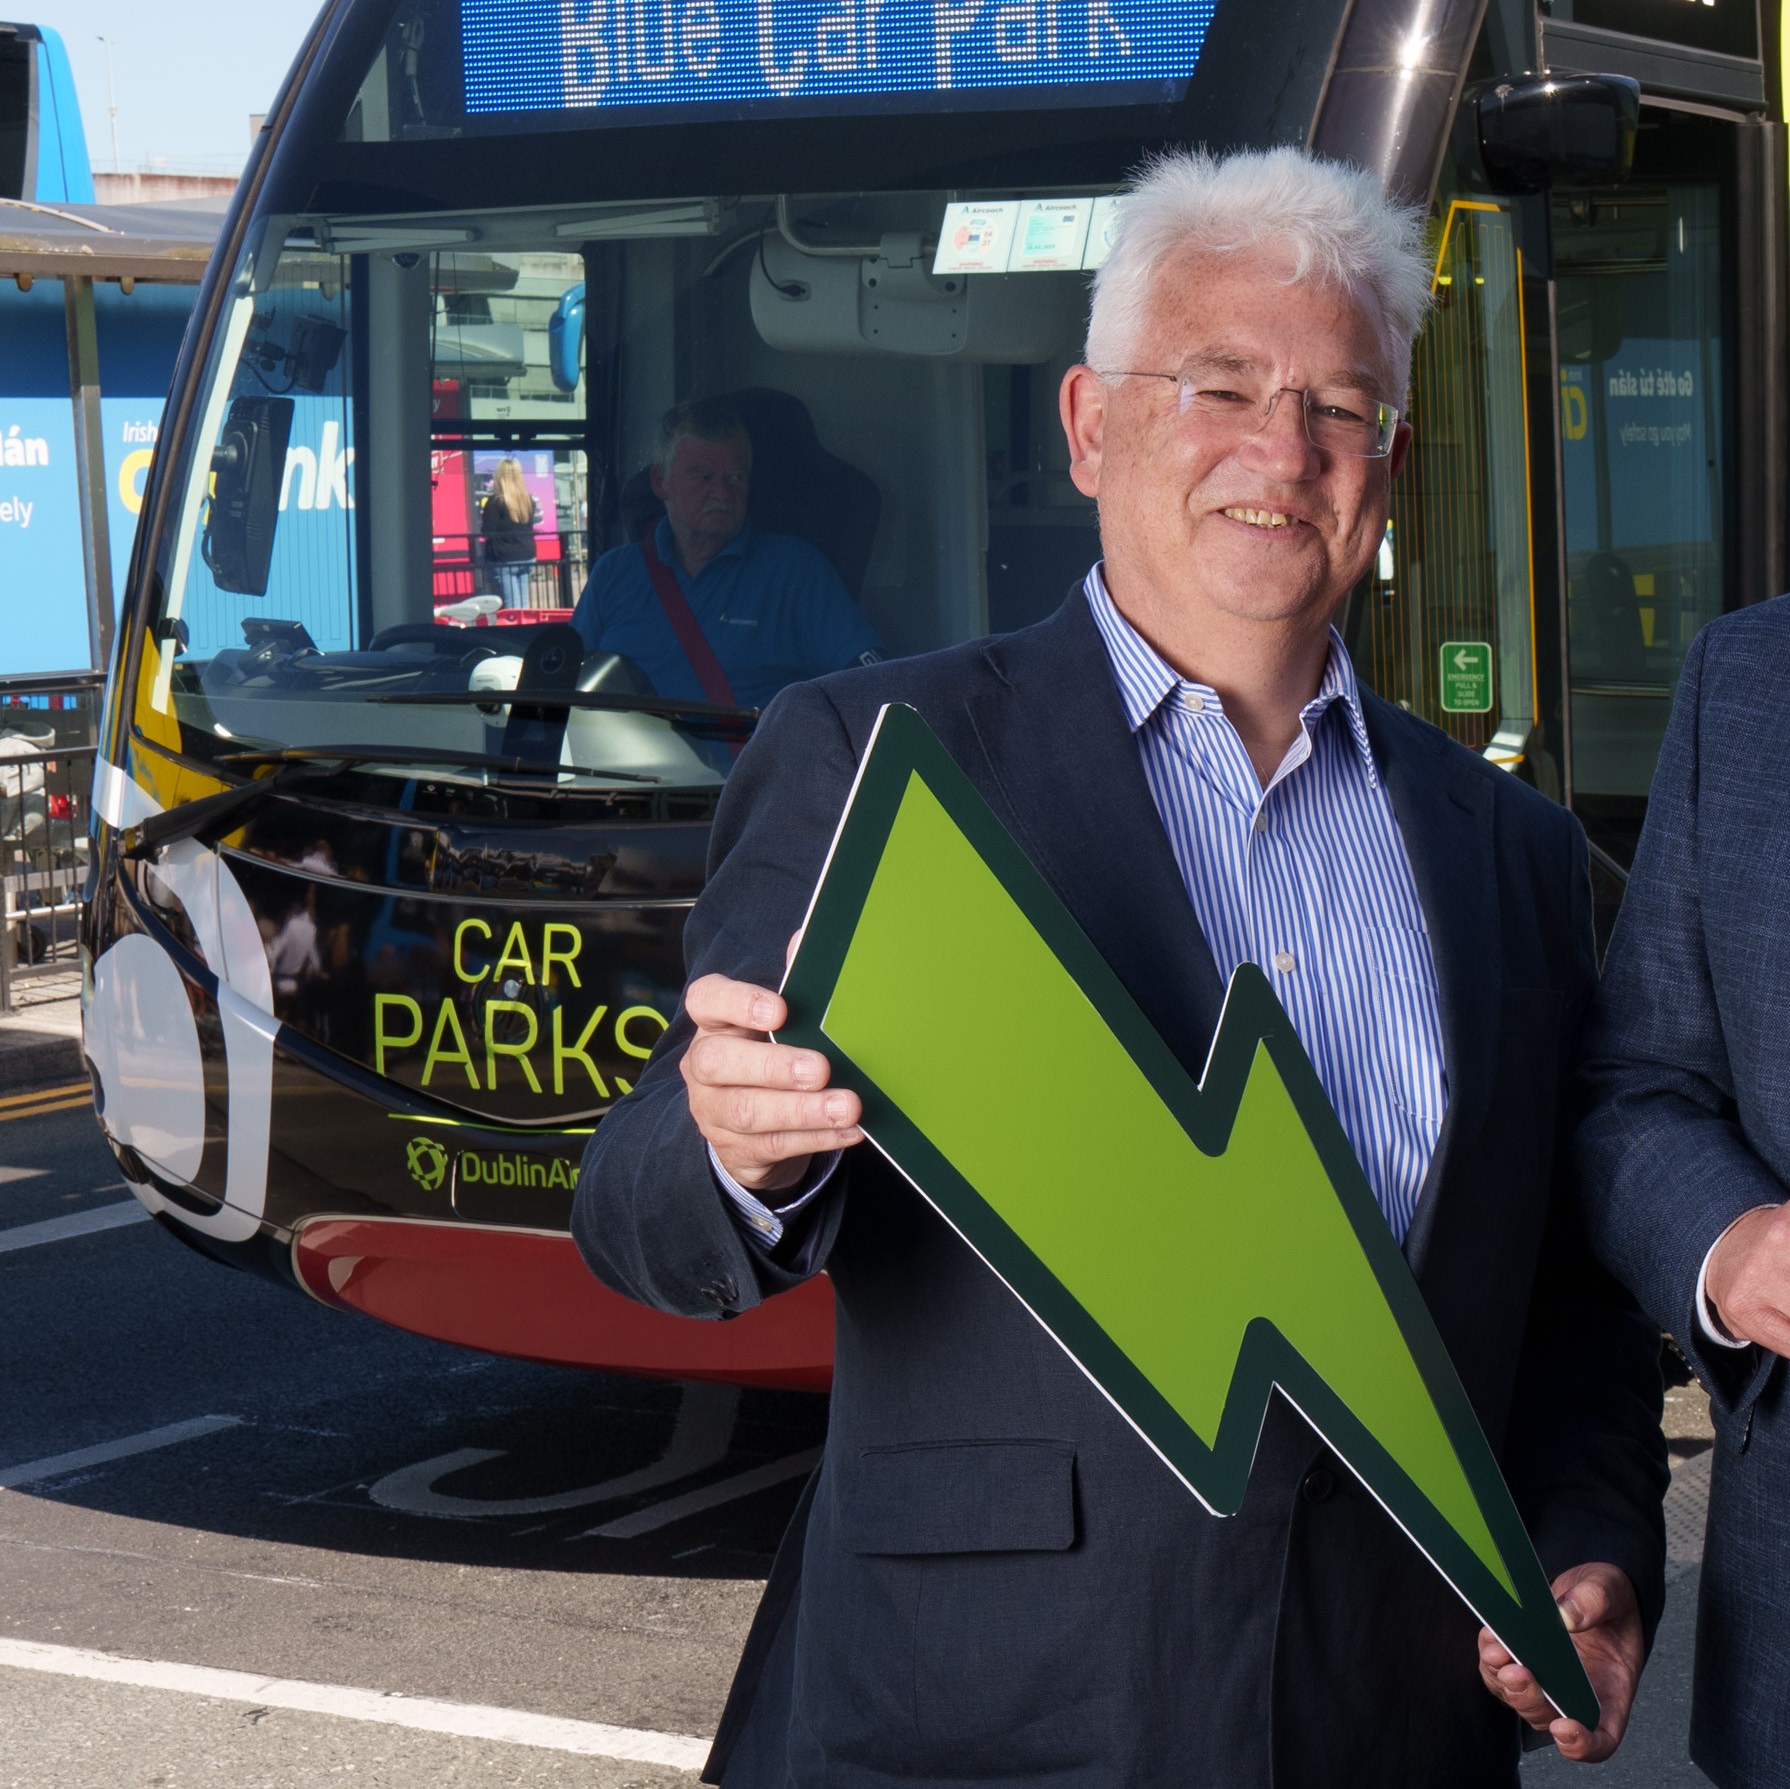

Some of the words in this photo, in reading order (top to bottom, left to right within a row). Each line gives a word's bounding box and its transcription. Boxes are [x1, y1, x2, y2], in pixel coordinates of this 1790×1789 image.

[1045, 203, 1078, 211] Aircoach
[453, 918, 583, 987] CAR
[375, 993, 670, 1098] PARKS
